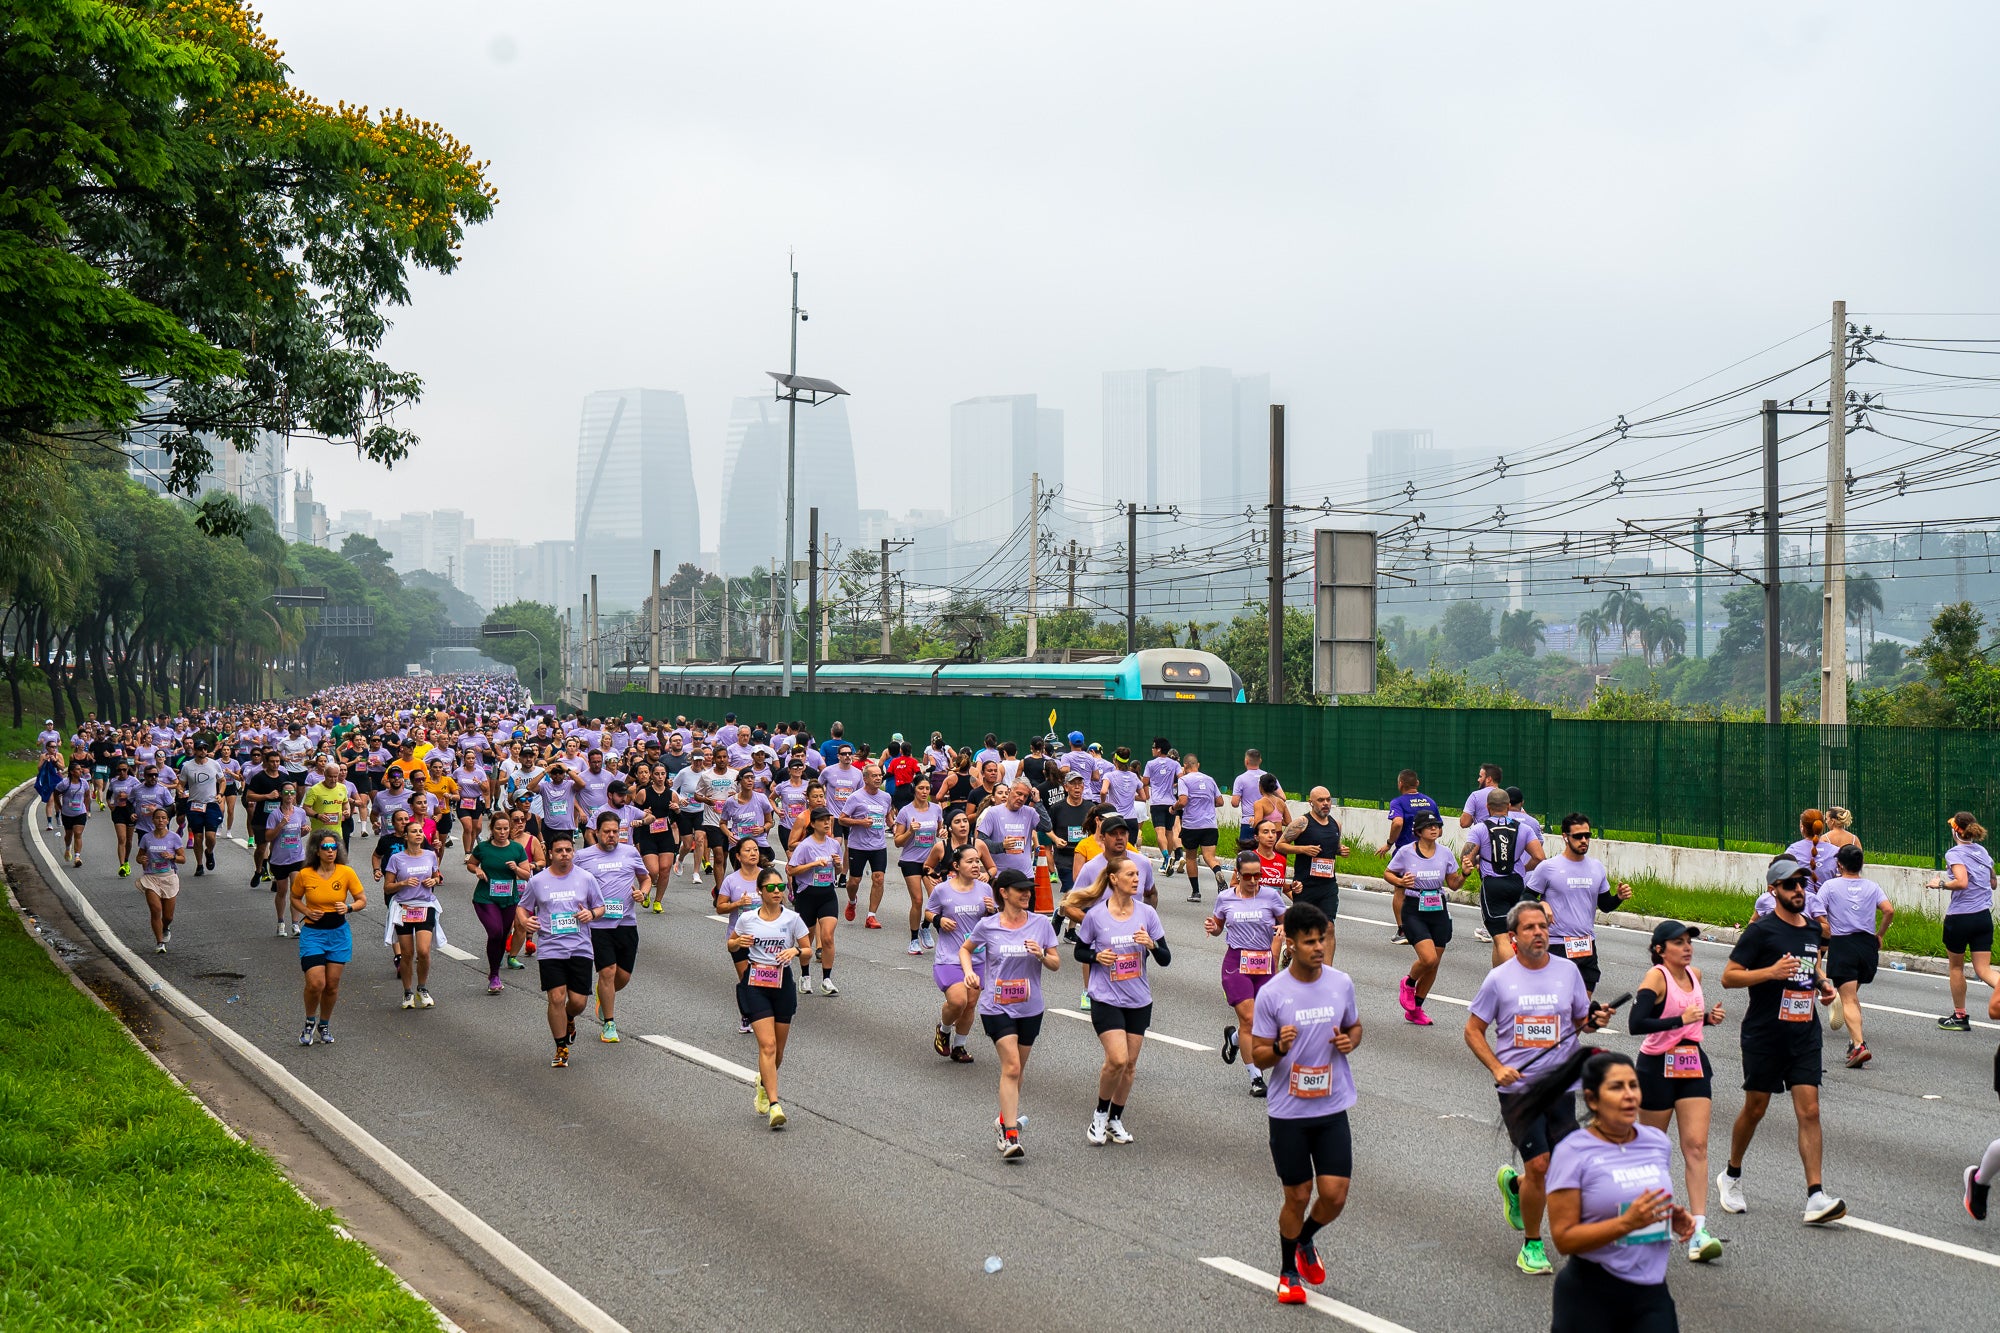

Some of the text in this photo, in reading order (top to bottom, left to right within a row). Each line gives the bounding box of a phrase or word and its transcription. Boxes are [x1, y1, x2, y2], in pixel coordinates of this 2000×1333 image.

[1233, 910, 1263, 919] ATHENAS
[753, 937, 786, 946] Prime
[764, 945, 782, 954] run
[999, 944, 1027, 953] ATHENA
[1119, 960, 1137, 970] 9288
[1249, 957, 1266, 965] 9394
[1004, 986, 1025, 995] 11318
[1518, 993, 1559, 1006] ATHENAS
[1295, 1006, 1335, 1021] ATHENAS
[1527, 1025, 1552, 1035] 9848
[1679, 1055, 1698, 1065] 9179
[1303, 1074, 1325, 1086] 9817
[1612, 1163, 1661, 1183] ATHENAS
